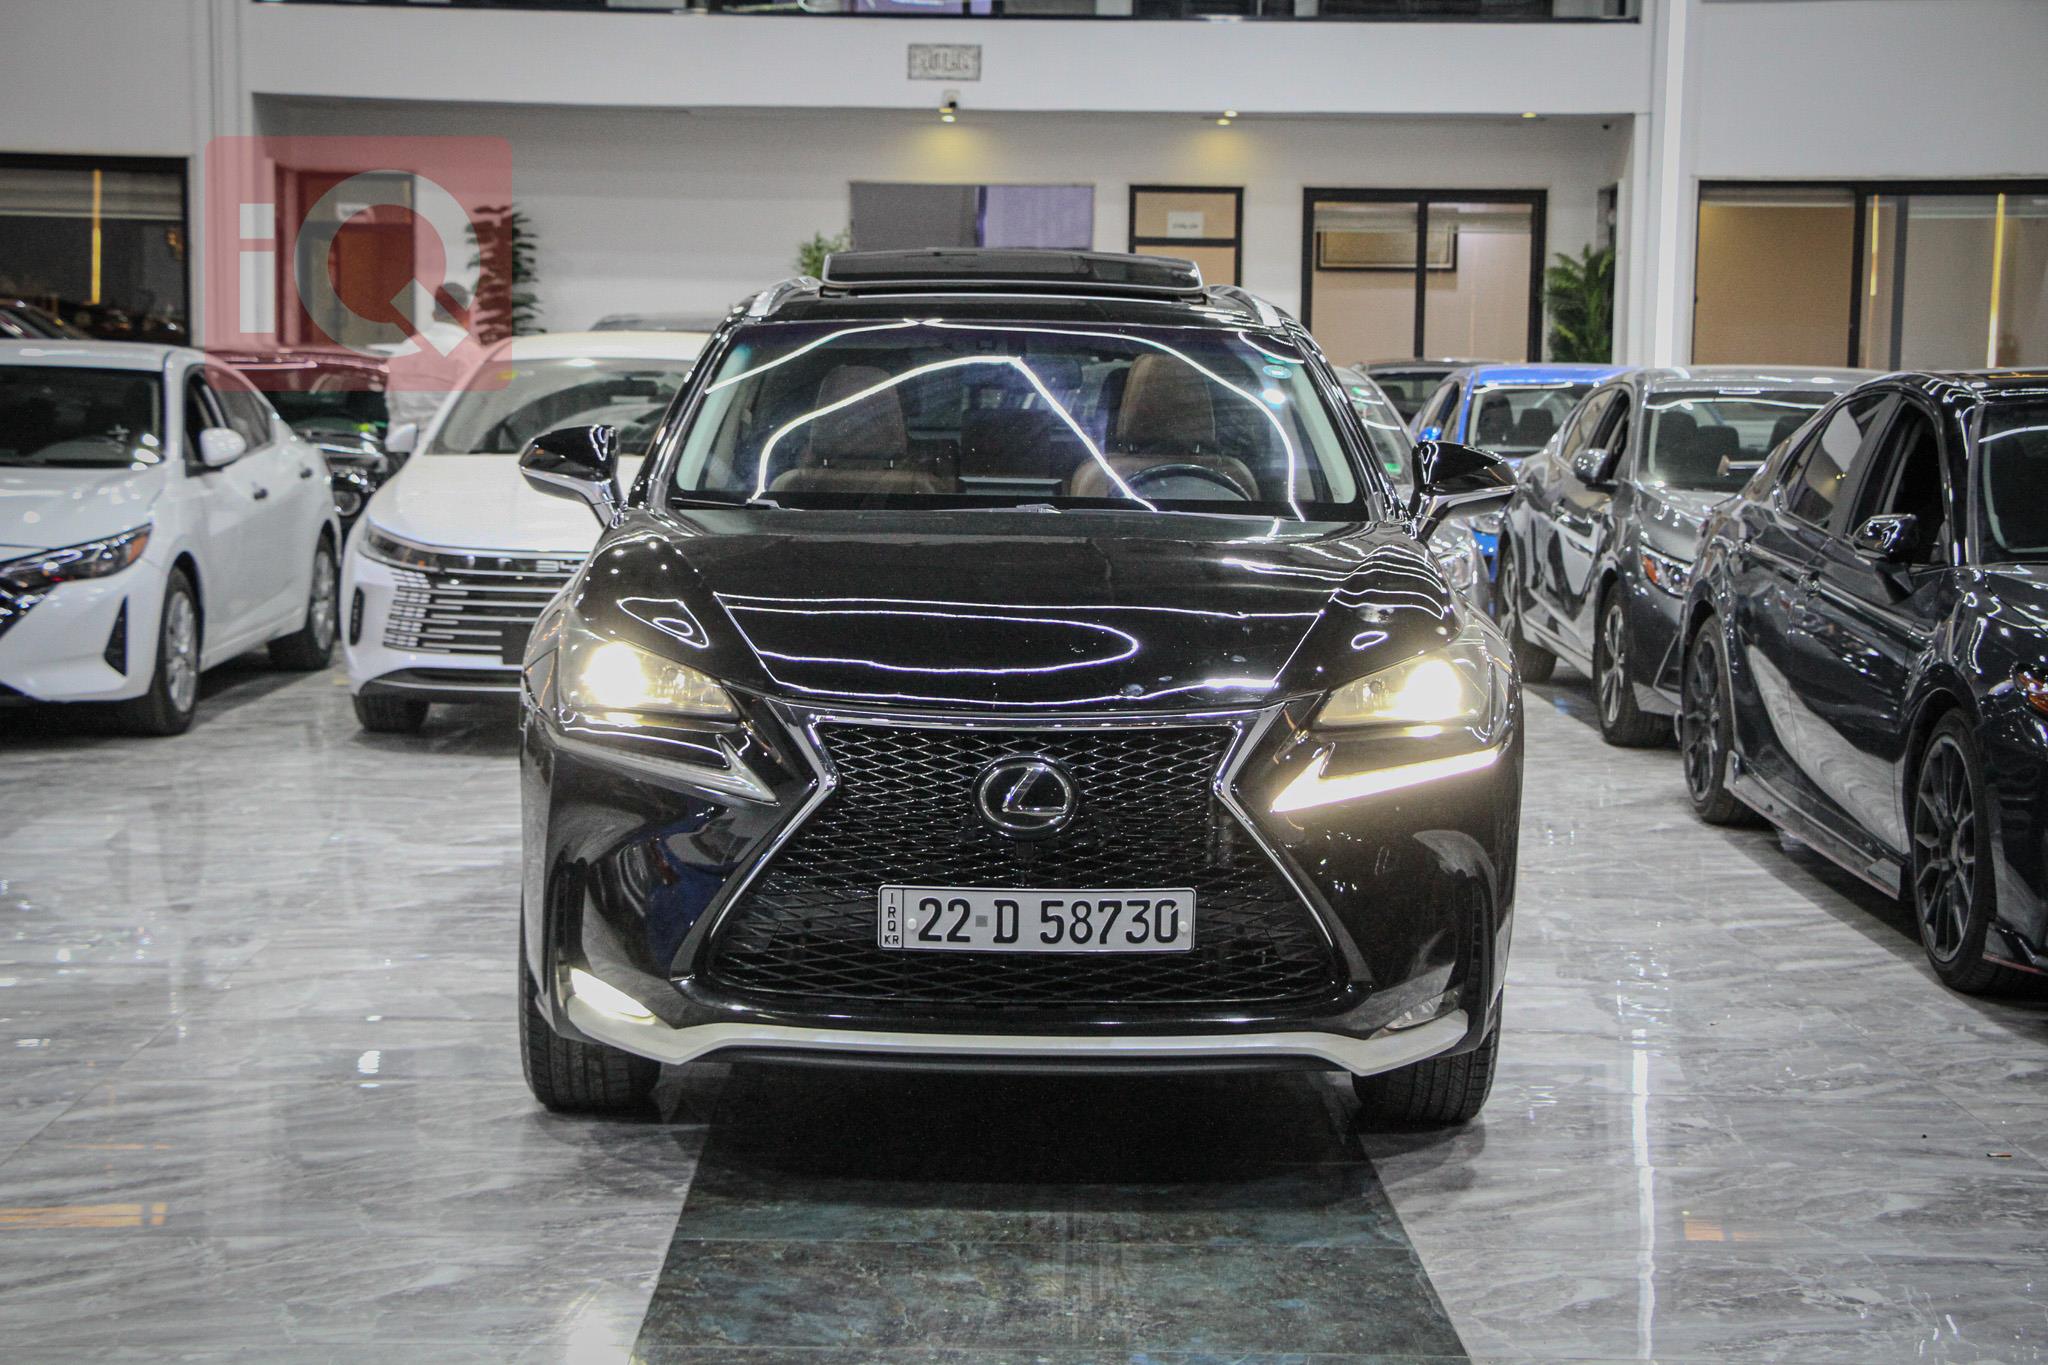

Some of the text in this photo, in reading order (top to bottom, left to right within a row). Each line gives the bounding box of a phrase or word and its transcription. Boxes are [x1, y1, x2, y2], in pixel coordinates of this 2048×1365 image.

[536, 560, 585, 573] BY
[887, 893, 896, 932] IRQ
[918, 897, 1179, 945] 22 D 58730
[884, 935, 899, 945] KR
